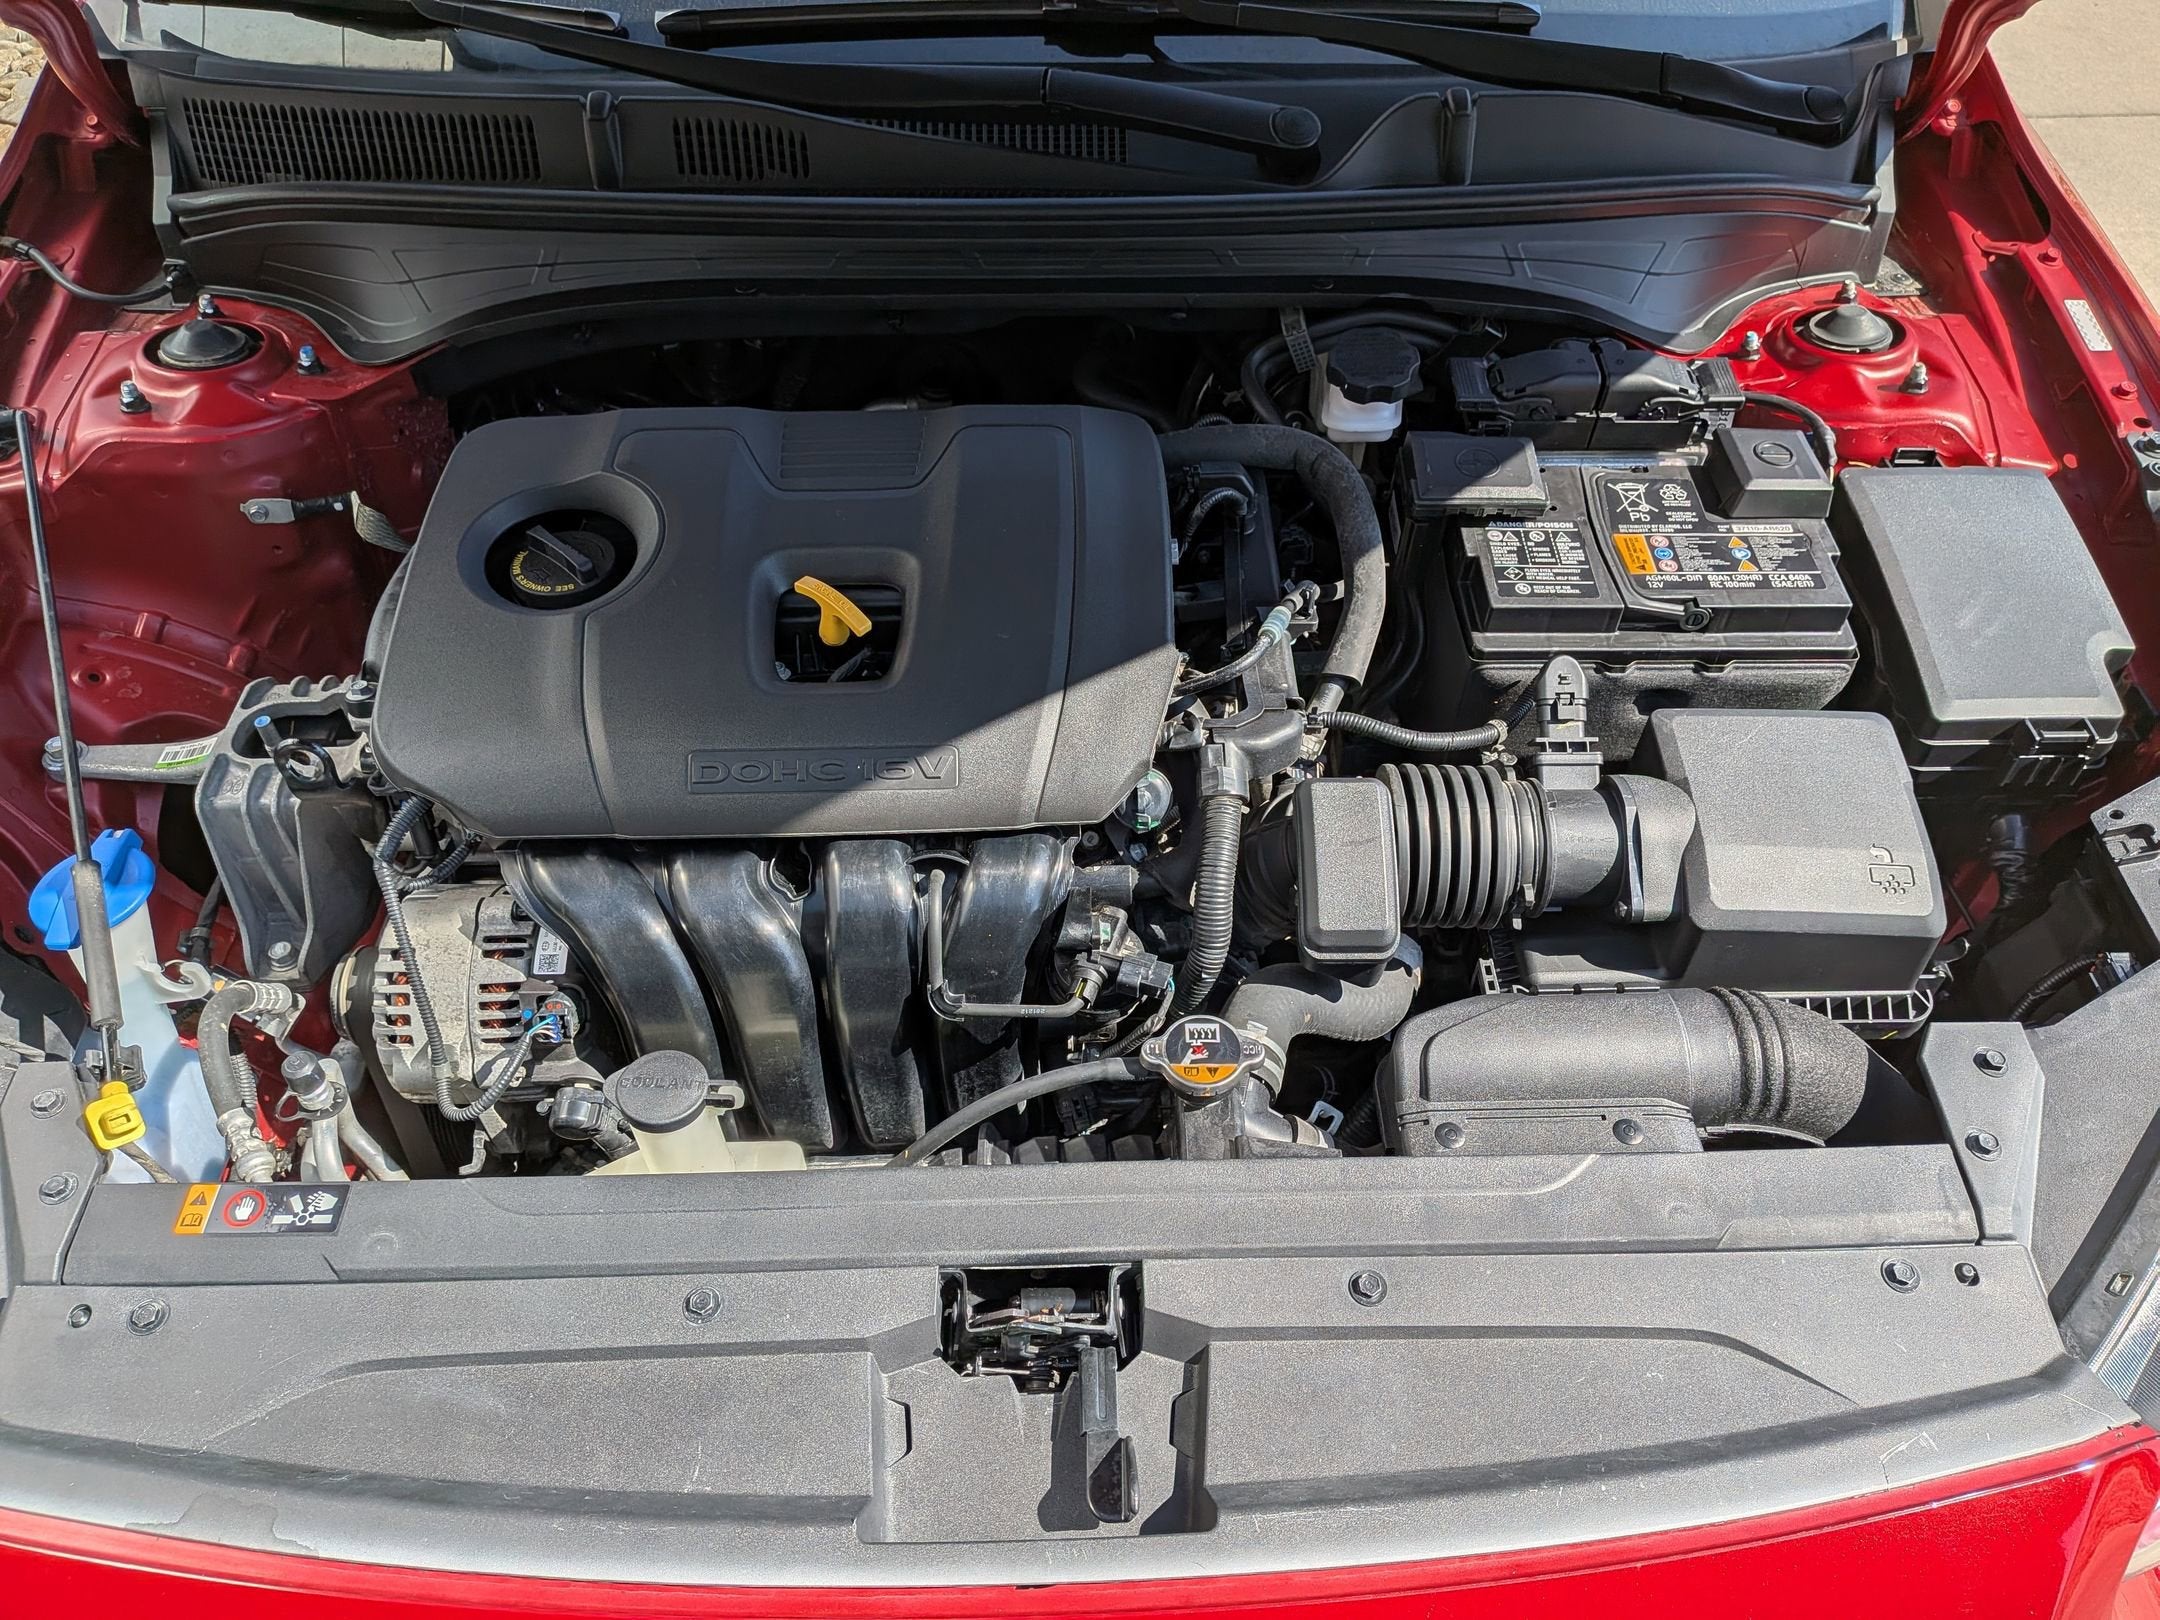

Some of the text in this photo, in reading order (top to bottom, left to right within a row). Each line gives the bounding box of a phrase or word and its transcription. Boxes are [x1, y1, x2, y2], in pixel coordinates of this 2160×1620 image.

[1629, 512, 1650, 522] Pb
[511, 550, 529, 575] MANUAL
[555, 583, 575, 592] SEE
[691, 754, 954, 784] DOHC 16V
[620, 1077, 701, 1089] COOLANT
